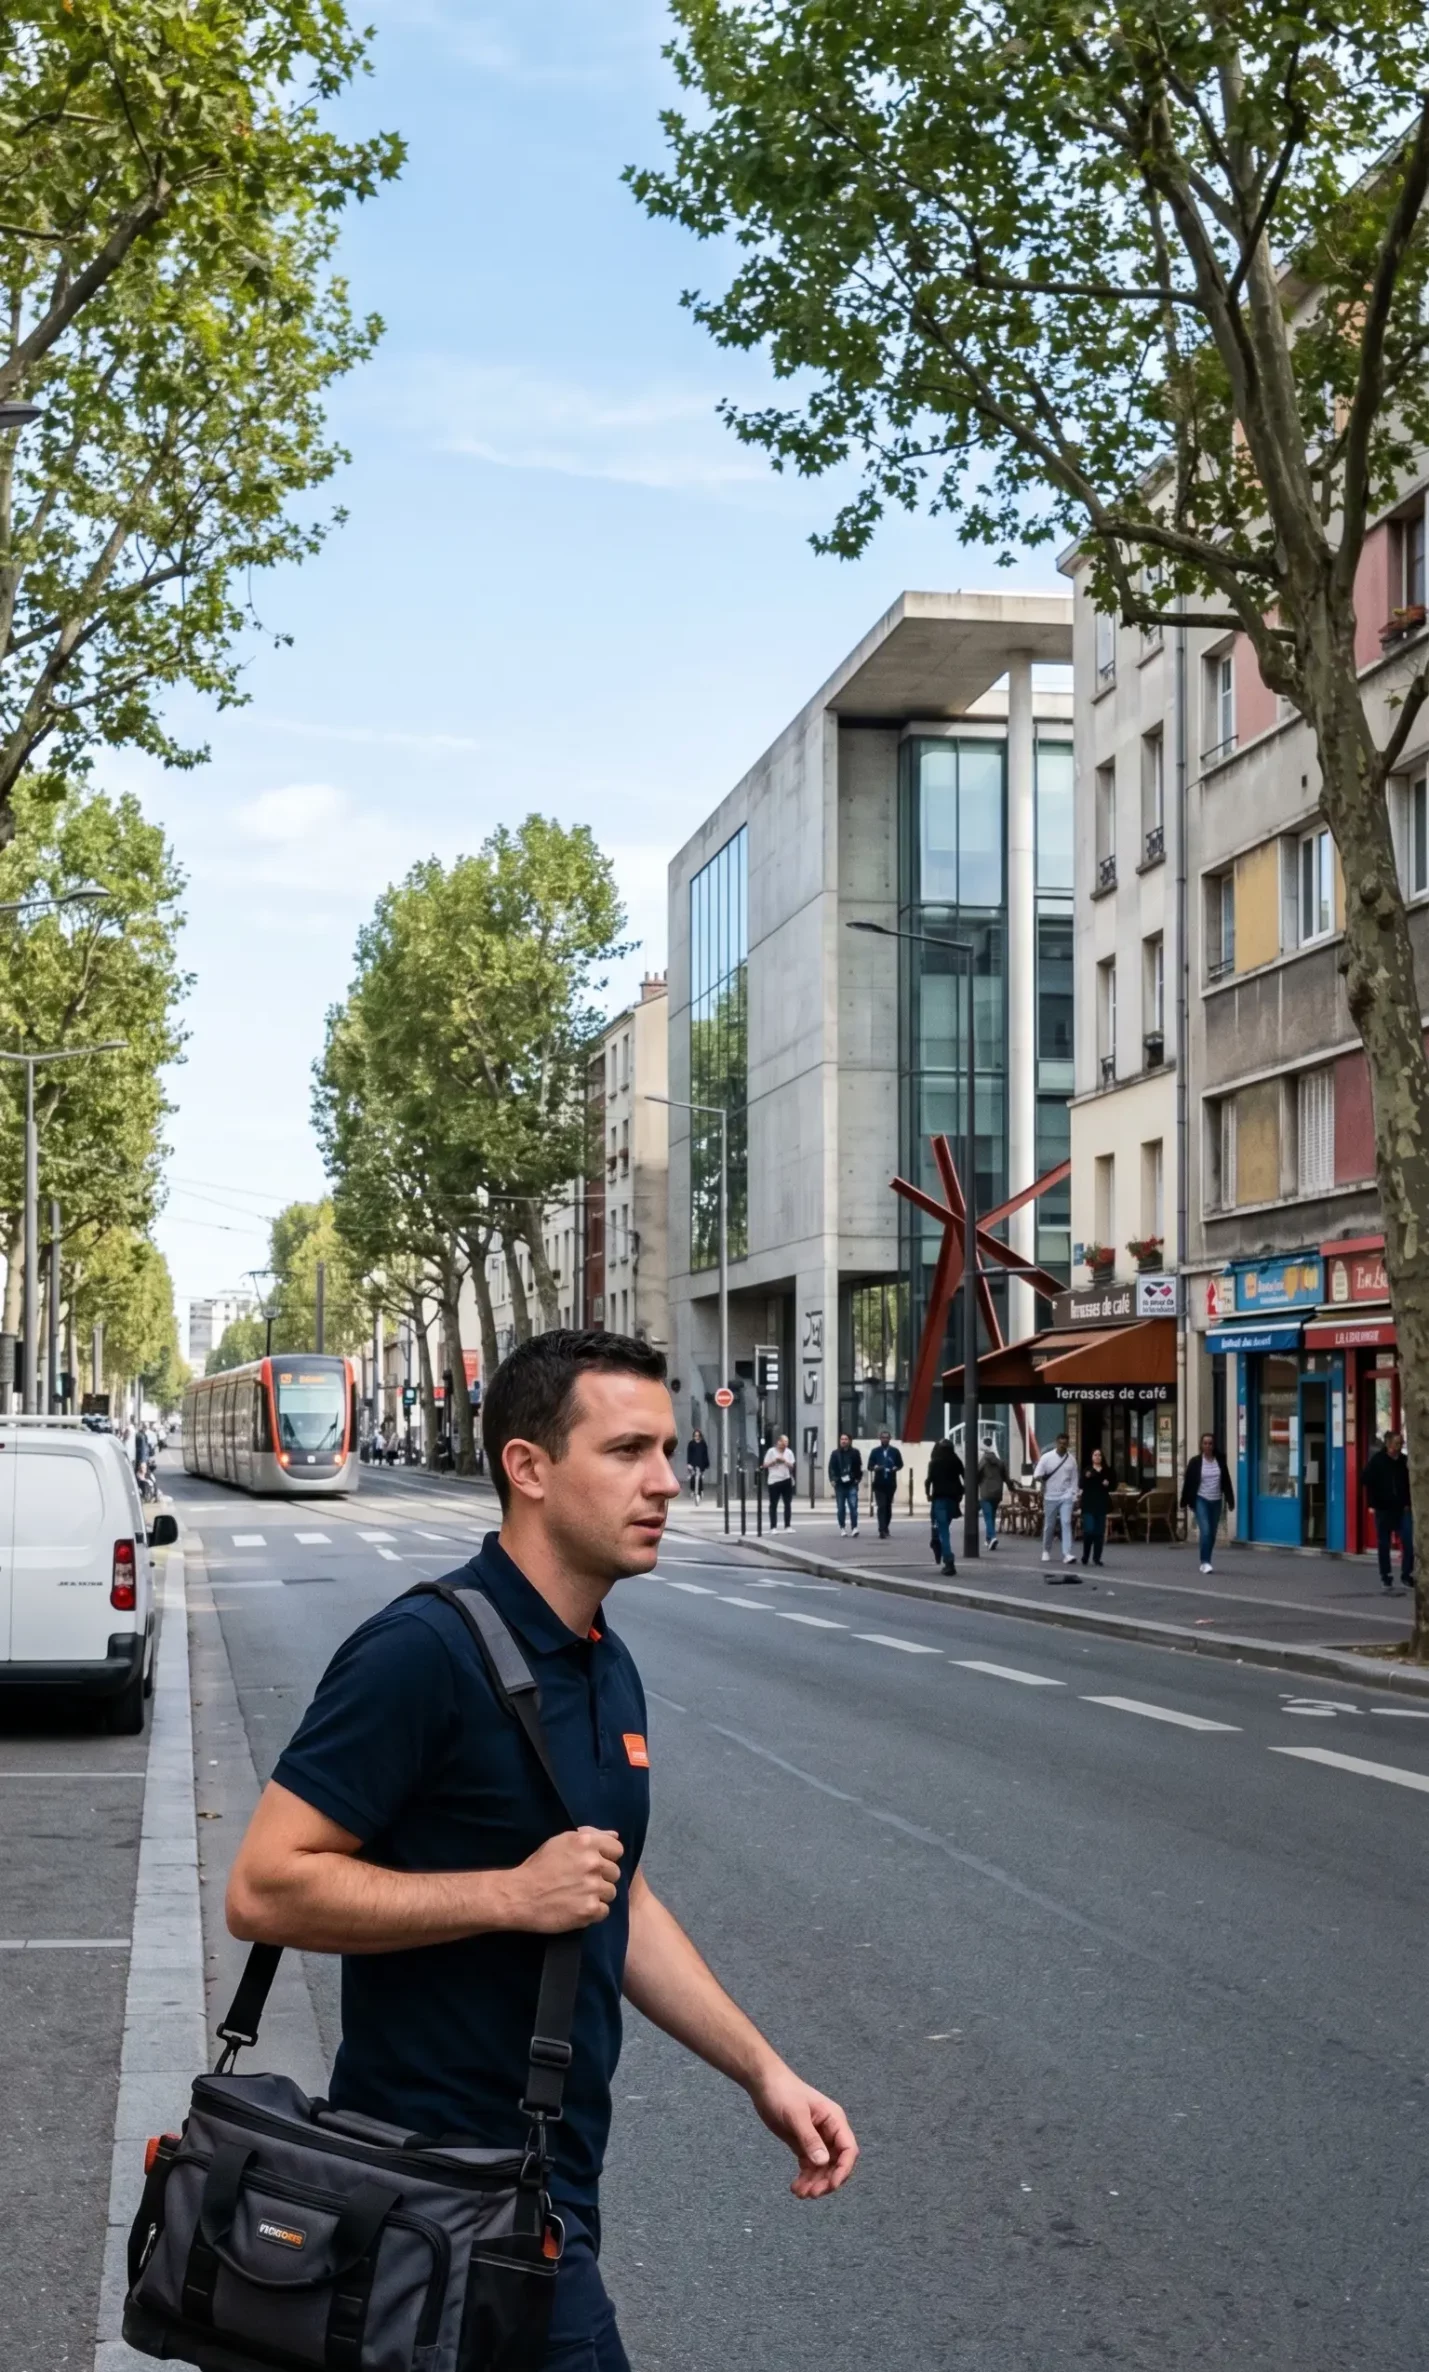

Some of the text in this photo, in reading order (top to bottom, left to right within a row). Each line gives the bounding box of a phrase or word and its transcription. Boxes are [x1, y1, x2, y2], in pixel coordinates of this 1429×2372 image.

[1113, 1293, 1130, 1314] café
[1055, 1386, 1167, 1399] Terrasses de café
